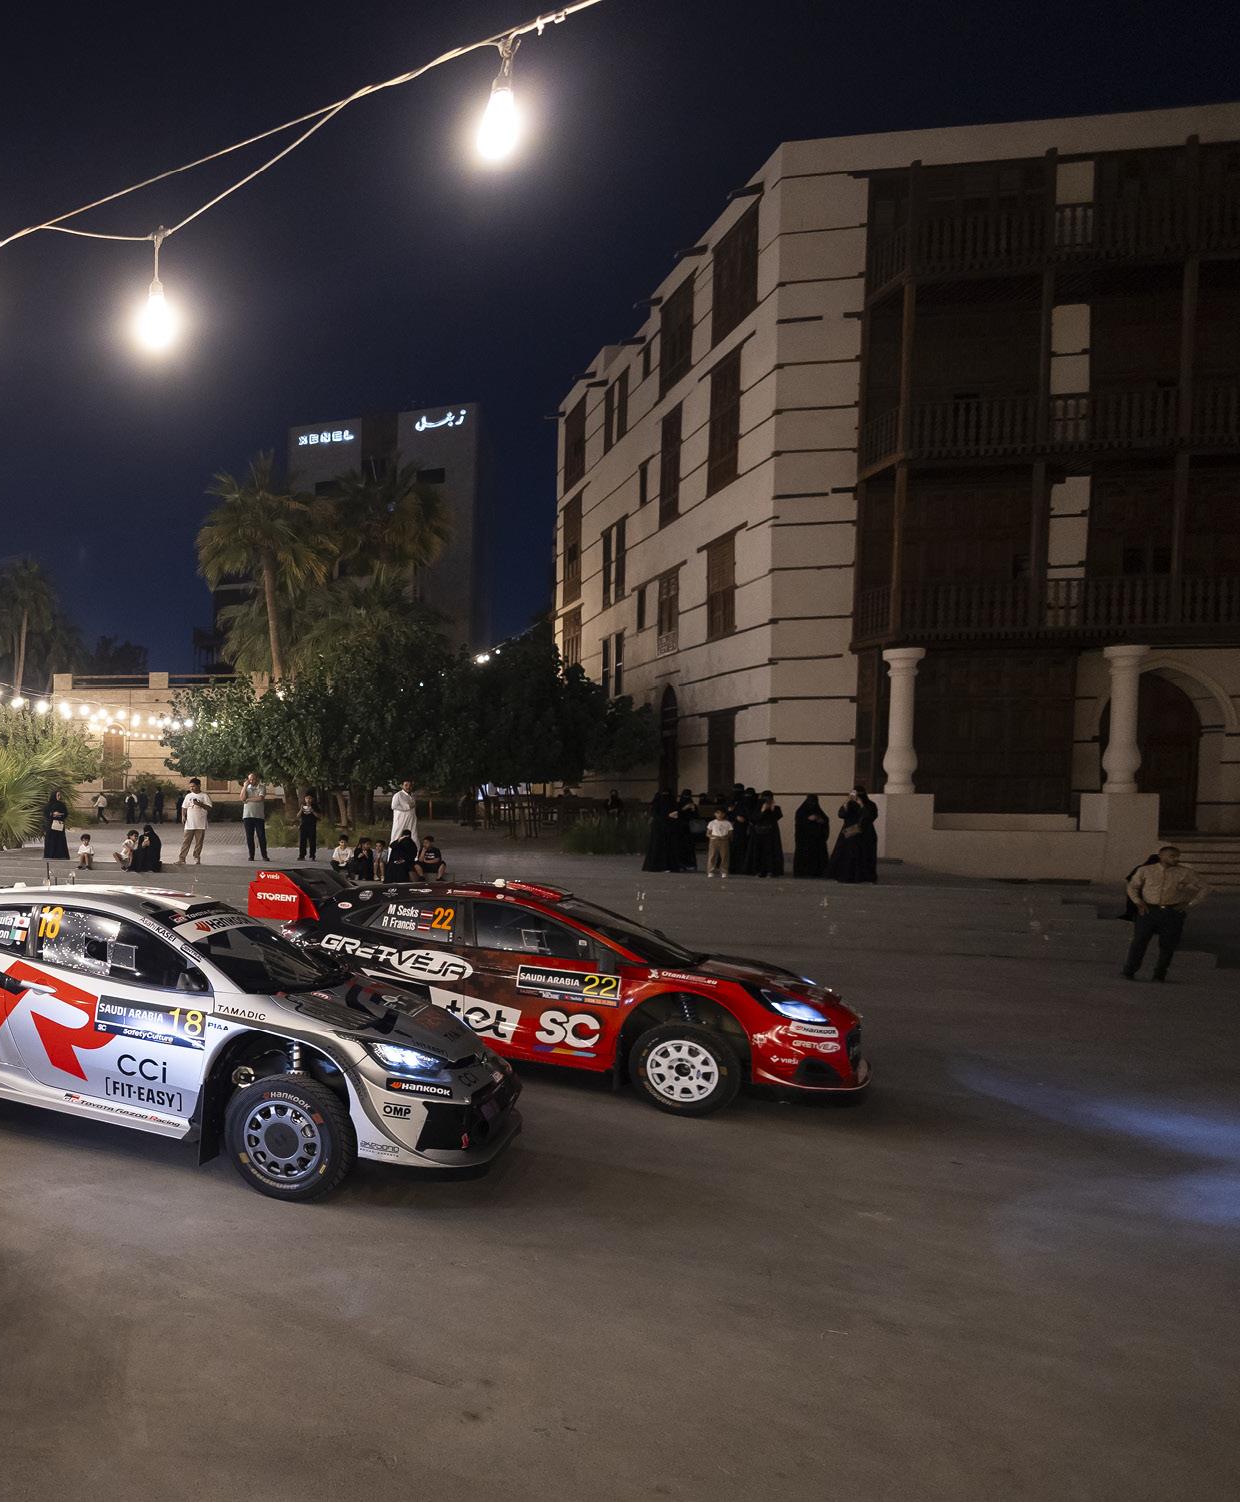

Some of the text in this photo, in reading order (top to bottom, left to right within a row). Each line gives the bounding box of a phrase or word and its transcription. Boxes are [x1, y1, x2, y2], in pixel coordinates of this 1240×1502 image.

[299, 430, 354, 446] XENEL
[256, 891, 297, 903] STORENT
[387, 904, 419, 918] M Sesks
[431, 907, 454, 931] 22
[38, 905, 64, 938] 18
[382, 916, 416, 931] R Francis
[520, 972, 617, 998] SAUDI ARABIA 22
[99, 1003, 203, 1036] SAUDI ARABIA 18
[217, 1004, 266, 1021] TAMADIC
[97, 1023, 107, 1032] SC
[207, 1022, 229, 1031] PIAA
[536, 1010, 600, 1048] SC
[123, 1028, 174, 1043] SafetyCulture
[117, 1054, 167, 1084] CCi
[80, 1099, 114, 1111] TOYOTA
[148, 1115, 180, 1128] Racing
[383, 1106, 412, 1118] OMP
